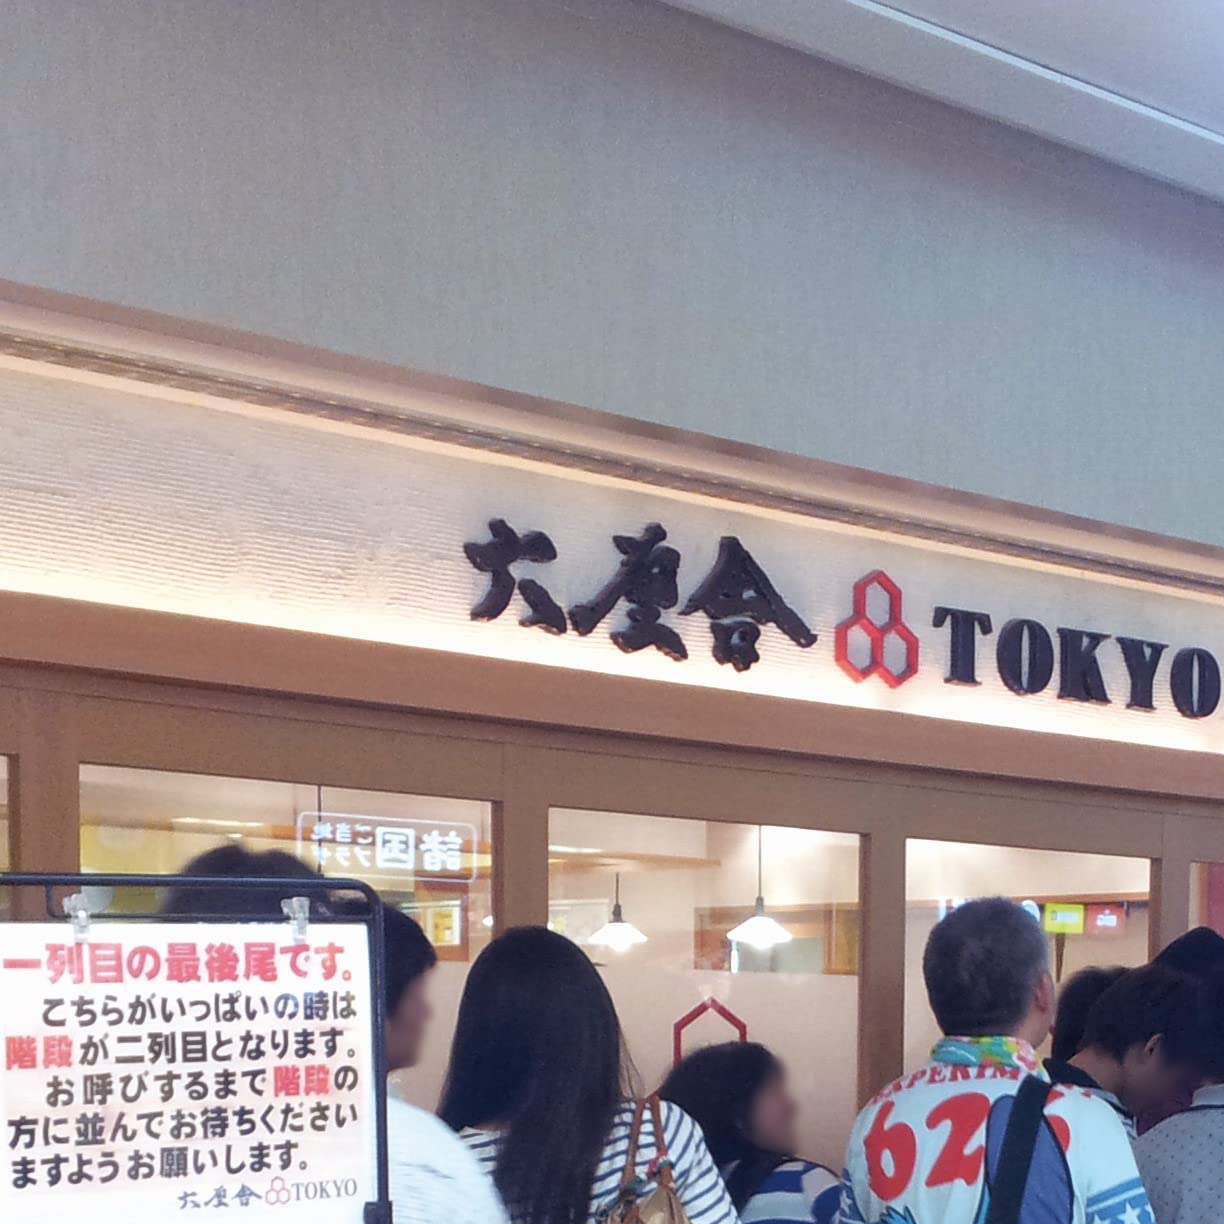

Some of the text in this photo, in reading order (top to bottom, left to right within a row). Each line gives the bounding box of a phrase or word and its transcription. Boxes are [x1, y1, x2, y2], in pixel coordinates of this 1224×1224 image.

[932, 606, 1222, 719] TOKYO
[3, 942, 353, 984] 一列目の最後尾です。
[42, 989, 357, 1027] こちらがいっぱいの時は
[5, 1027, 356, 1071] 階段が二列目となります。
[46, 1064, 359, 1108] お呼びするまで階段の
[7, 1102, 358, 1150] 方に並んでお待ちください
[12, 1139, 309, 1189] ますようお願いします。
[291, 1178, 357, 1201] TOKYO
